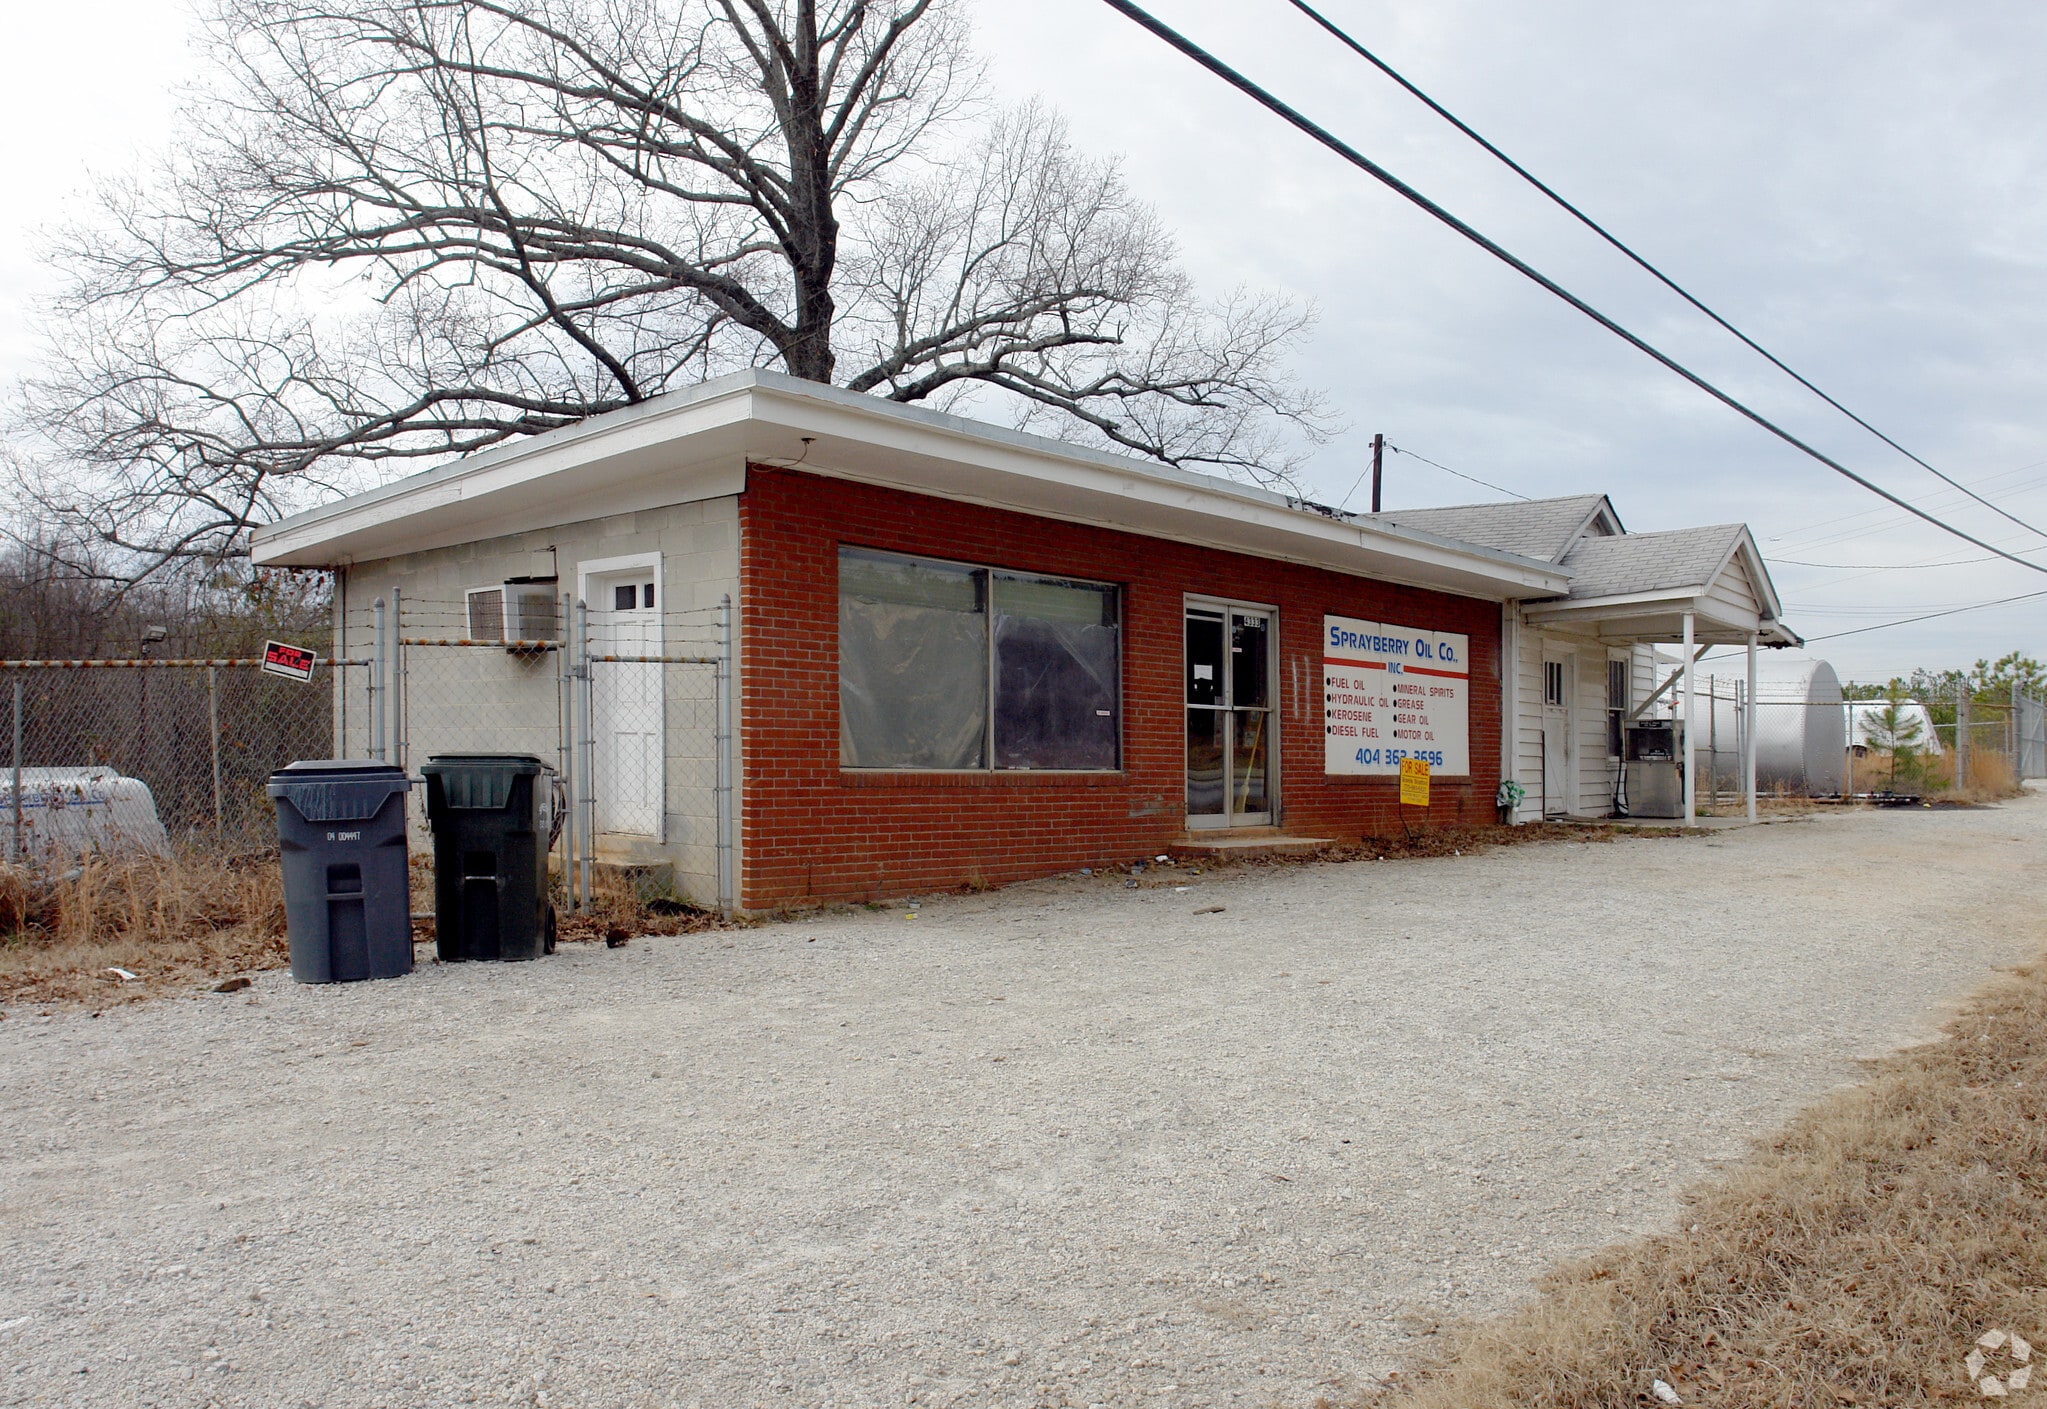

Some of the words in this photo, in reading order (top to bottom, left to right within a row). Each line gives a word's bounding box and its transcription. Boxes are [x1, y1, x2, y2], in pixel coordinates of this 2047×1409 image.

[1330, 626, 1409, 655] SPRAYBERRY
[1415, 638, 1433, 658] OIL
[278, 646, 302, 658] FOR
[266, 651, 311, 671] SALE
[1387, 661, 1403, 675] INC.
[1331, 677, 1350, 689] FUEL
[1353, 679, 1365, 690] OIL
[1397, 683, 1426, 696] MINERAL
[1429, 686, 1454, 698] SPIRITS
[1331, 693, 1375, 707] HYDRAULIC
[1378, 697, 1389, 708] OIL
[1397, 698, 1425, 710] GREASE
[1331, 709, 1372, 722] KEROSENE
[1397, 713, 1416, 724] GEAR
[1419, 715, 1429, 726] OIL
[1331, 725, 1358, 737] DIESEL
[1361, 727, 1379, 738] FUEL
[1397, 729, 1421, 740] MOTOR
[1424, 731, 1434, 741] OIL
[1355, 747, 1381, 765] 404
[1401, 760, 1413, 774] FOR
[1414, 762, 1429, 777] SALE
